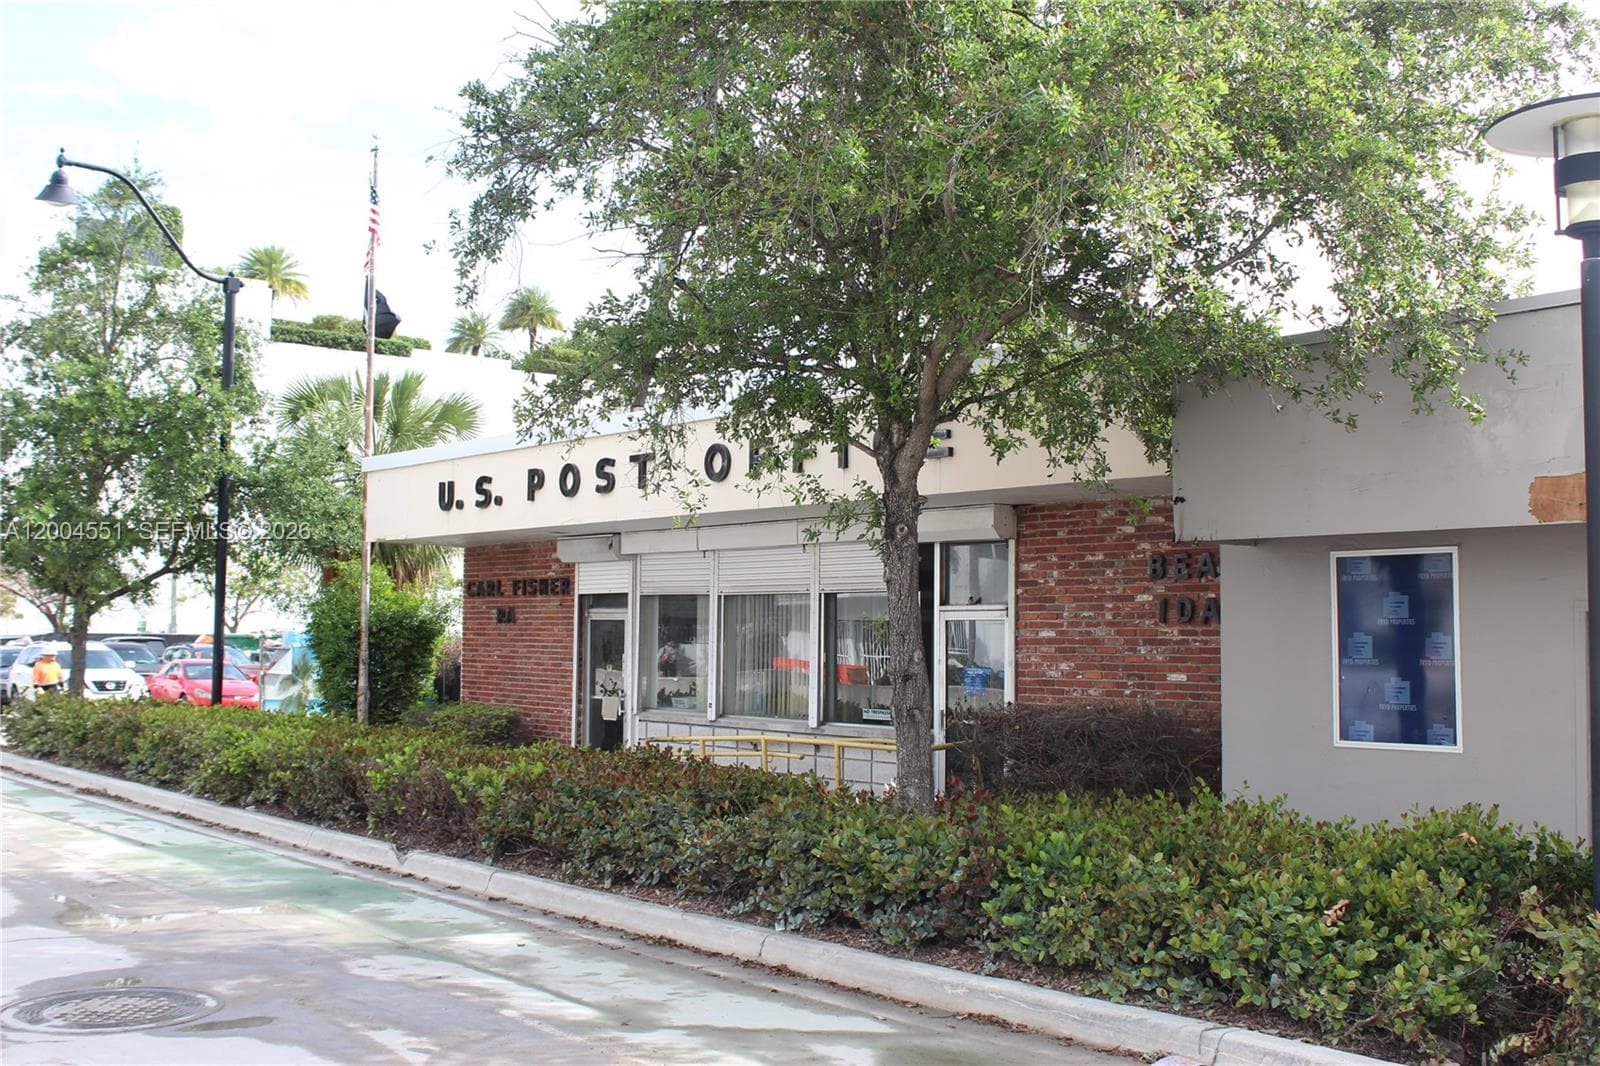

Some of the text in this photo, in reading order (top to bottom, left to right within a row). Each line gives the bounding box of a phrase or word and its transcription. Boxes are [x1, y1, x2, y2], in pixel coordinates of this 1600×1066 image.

[527, 452, 656, 502] POST
[466, 576, 571, 597] CARL FISHER
